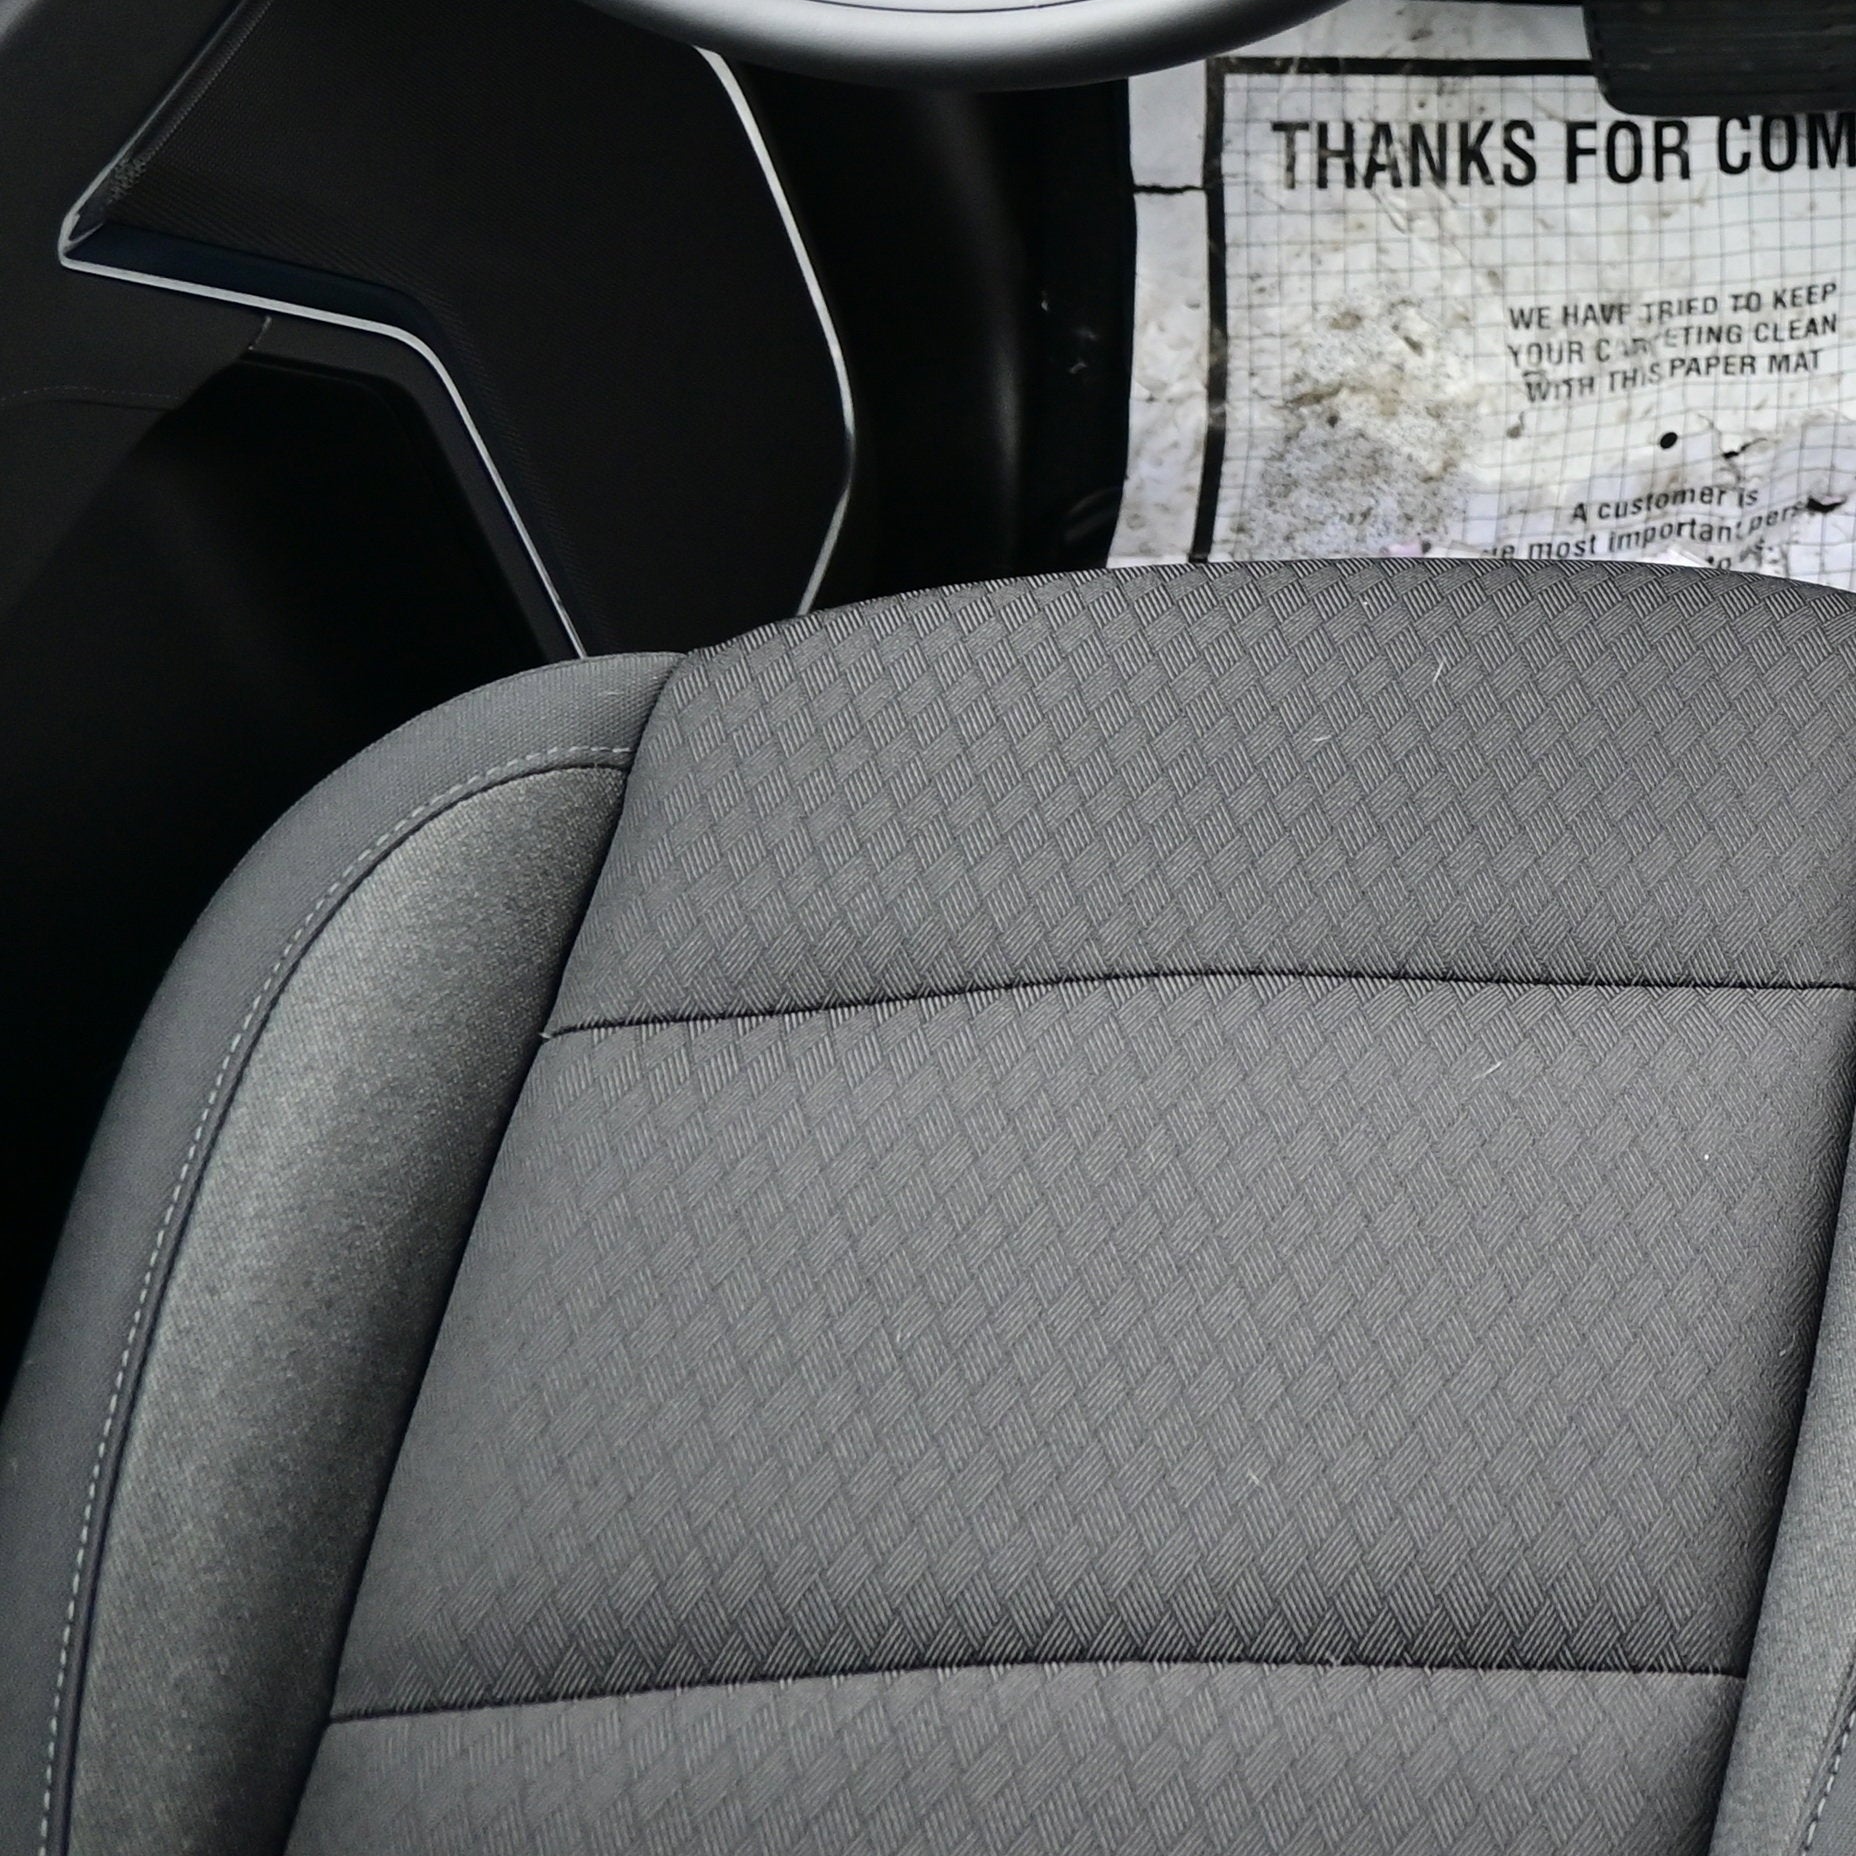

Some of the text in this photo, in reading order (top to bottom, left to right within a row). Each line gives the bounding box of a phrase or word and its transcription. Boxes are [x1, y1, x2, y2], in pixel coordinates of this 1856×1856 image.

[1271, 118, 1538, 190] THANKS
[1564, 118, 1691, 186] FOR
[1507, 281, 1838, 331] WE HAVE TRIED TO KEEP
[1507, 312, 1838, 369] YOUR CETING CLEAN
[1523, 348, 1825, 404] WITH THIS PAPER MAT
[1570, 483, 1759, 524] A customer is
[1527, 534, 1598, 561] most
[1606, 518, 1743, 553] important
